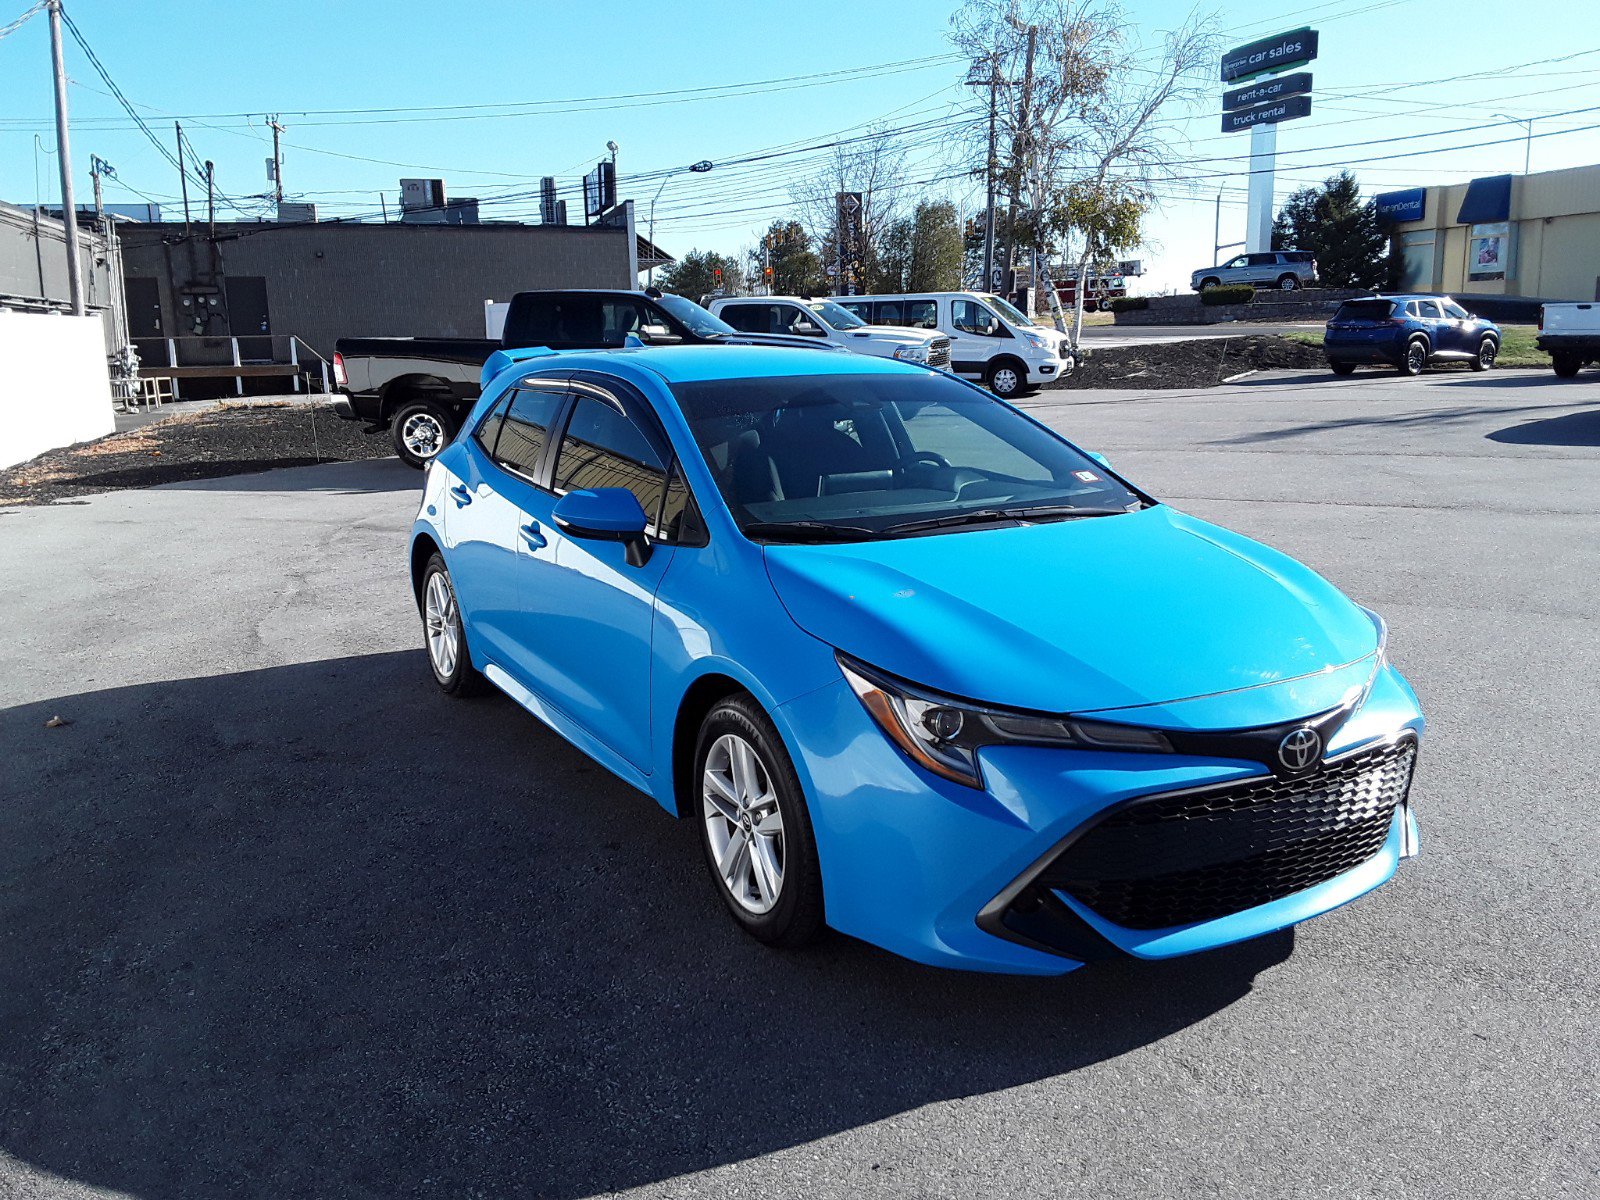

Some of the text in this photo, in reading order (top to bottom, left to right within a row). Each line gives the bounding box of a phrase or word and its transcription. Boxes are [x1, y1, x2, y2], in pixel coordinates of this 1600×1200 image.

[1249, 48, 1267, 64] car
[1269, 41, 1302, 59] sales
[1237, 83, 1282, 102] rent-a-car
[1233, 104, 1286, 125] truck rental
